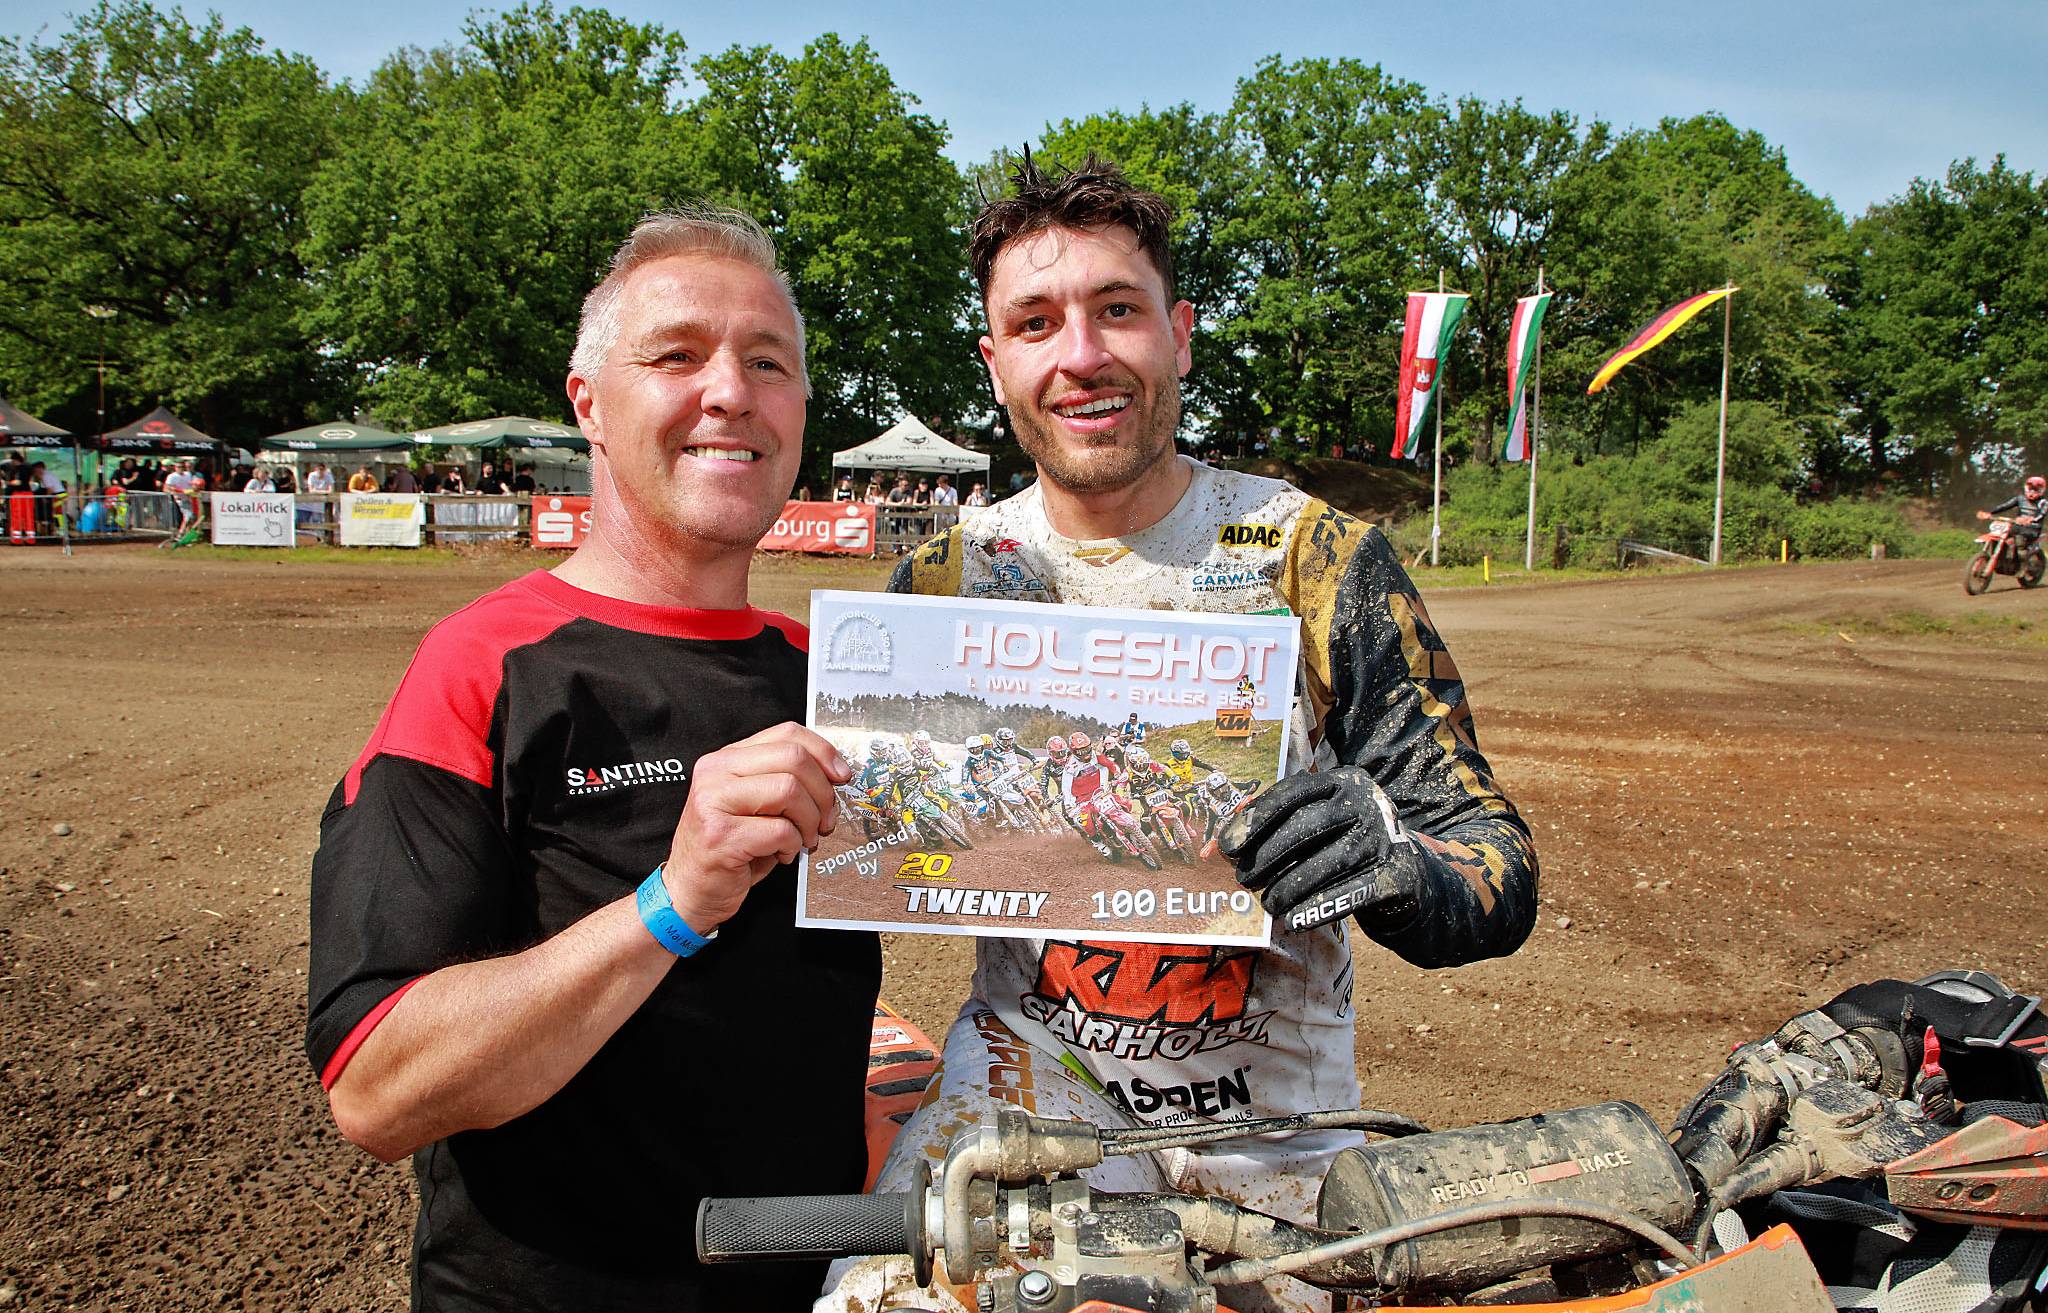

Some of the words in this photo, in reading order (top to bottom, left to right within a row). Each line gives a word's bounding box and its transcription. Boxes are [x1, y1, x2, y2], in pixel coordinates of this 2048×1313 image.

[221, 501, 288, 514] LokalKlick
[1221, 525, 1281, 548] ADAC
[953, 619, 1277, 686] HOLESHOT
[1039, 680, 1096, 700] 2024
[1128, 686, 1206, 707] EYLLER
[1216, 691, 1266, 711] BERG
[1216, 713, 1251, 731] KTM
[567, 758, 684, 788] SANTINO
[569, 783, 616, 796] CASUAL
[621, 774, 687, 788] WORKWEAR
[815, 829, 909, 875] sponsored
[855, 858, 879, 877] by
[897, 852, 953, 876] 20
[893, 884, 1050, 918] TWENTY
[1090, 888, 1156, 920] 100
[1165, 886, 1250, 916] Euro
[1034, 938, 1259, 1026] KTM
[1106, 1066, 1252, 1117] ASPEN
[1430, 1176, 1497, 1204] READY
[1577, 1149, 1633, 1174] RACE
